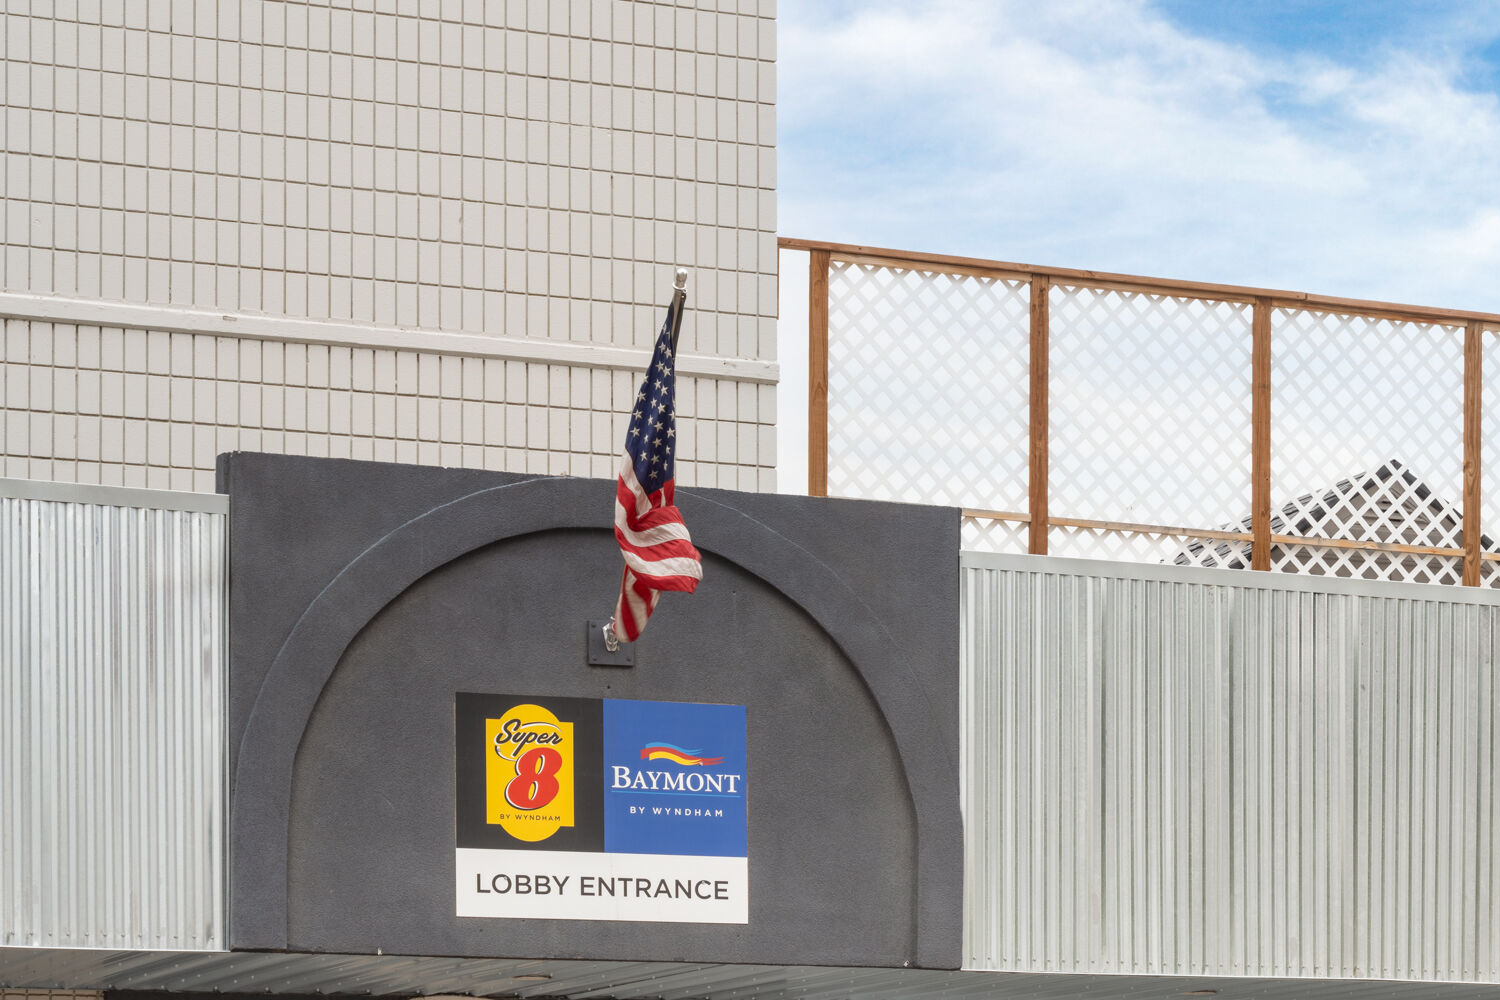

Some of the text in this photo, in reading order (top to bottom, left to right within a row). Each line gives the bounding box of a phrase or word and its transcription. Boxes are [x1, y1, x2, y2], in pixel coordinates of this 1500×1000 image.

[494, 718, 563, 758] Super
[505, 747, 563, 811] 8
[611, 765, 741, 793] BAYMONT
[500, 813, 561, 822] BY WYNDHAM
[629, 806, 724, 817] BY WYNDHAM
[476, 873, 729, 900] LOBBY ENTRANCE
